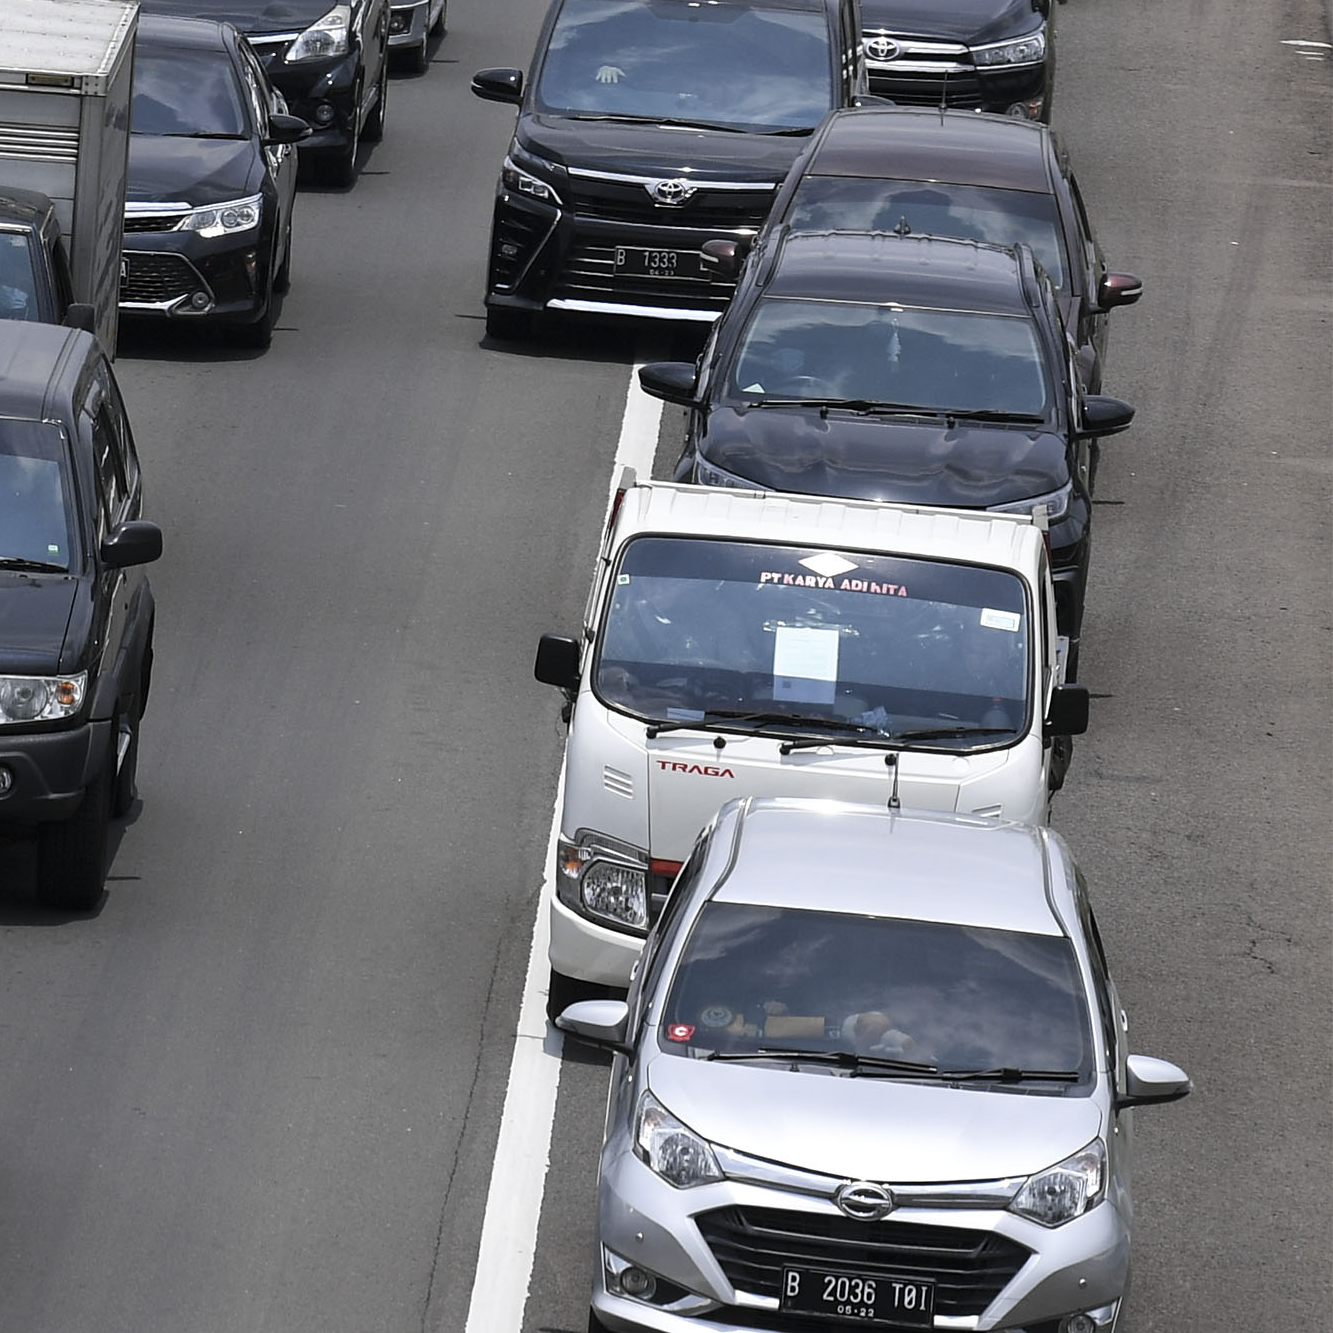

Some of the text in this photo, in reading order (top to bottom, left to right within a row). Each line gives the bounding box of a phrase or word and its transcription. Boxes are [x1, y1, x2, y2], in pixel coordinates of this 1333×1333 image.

[616, 249, 677, 268] B 1333
[760, 571, 782, 584] PT
[782, 574, 836, 589] KARYA
[840, 578, 868, 592] ADI
[656, 760, 735, 779] TRAGA
[786, 1271, 800, 1297] B
[822, 1275, 876, 1304] 2036
